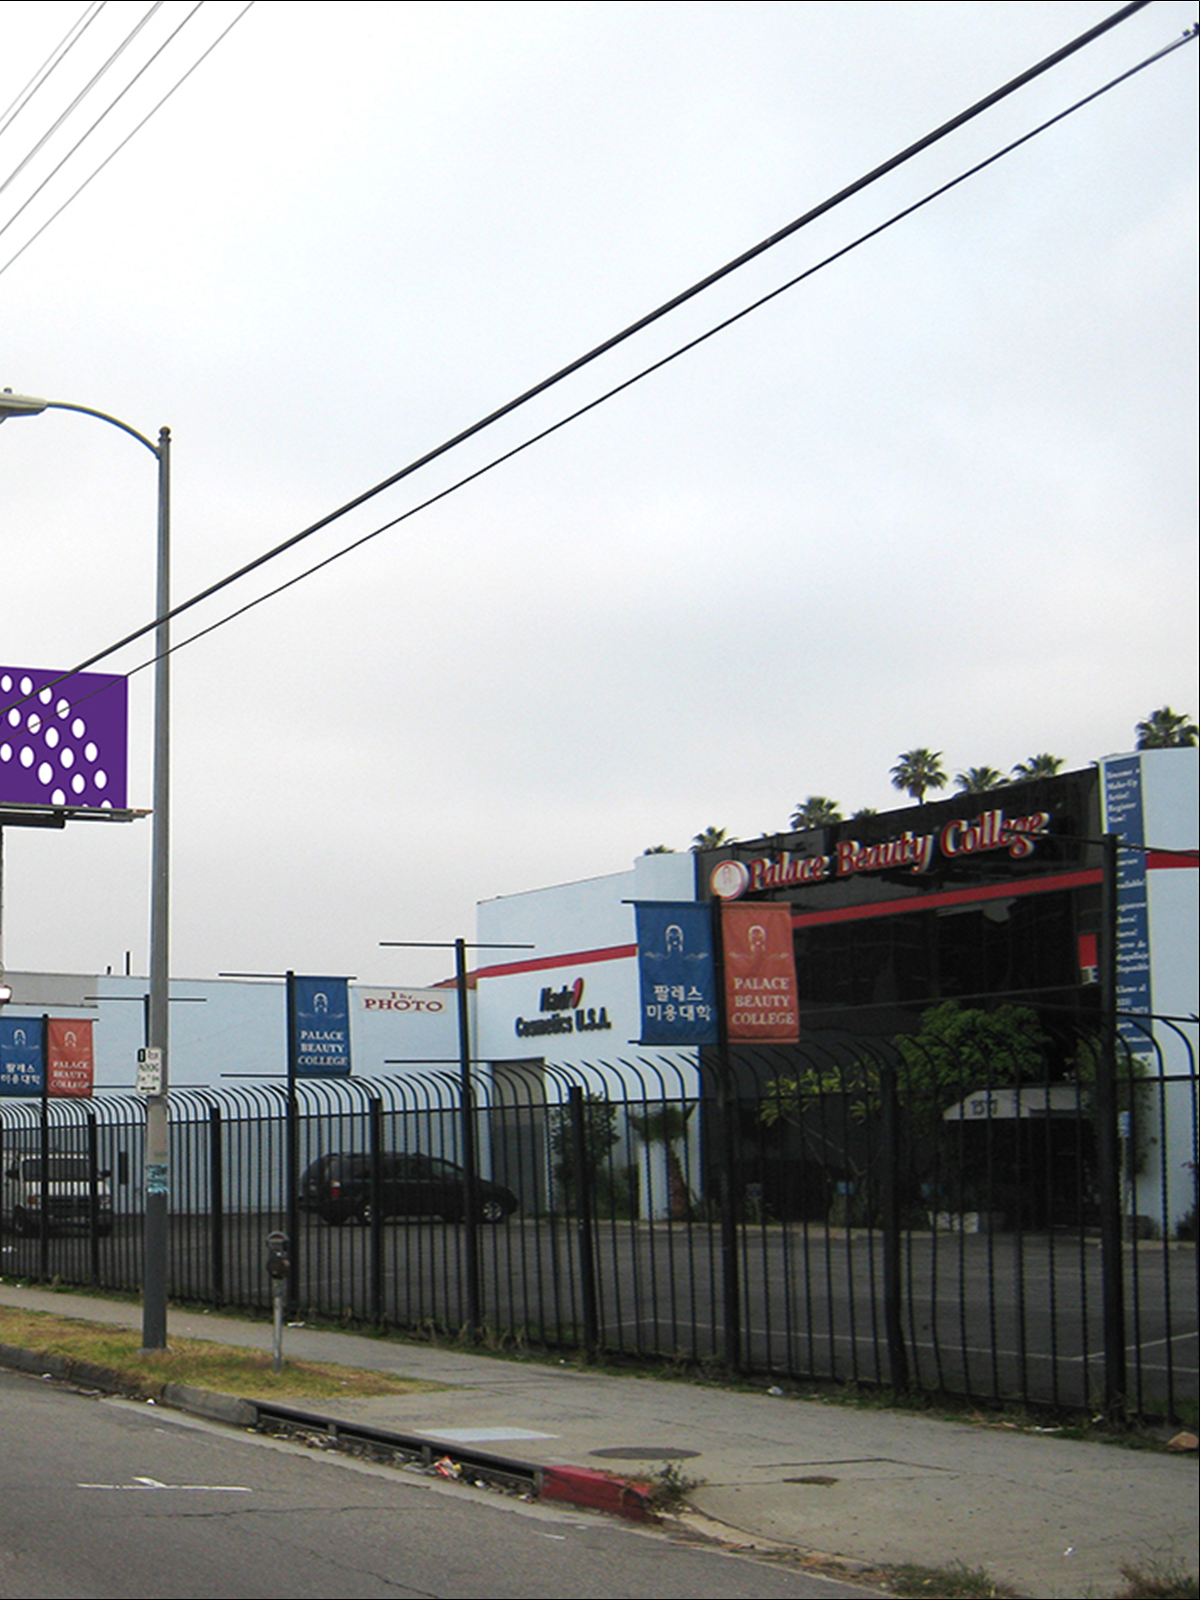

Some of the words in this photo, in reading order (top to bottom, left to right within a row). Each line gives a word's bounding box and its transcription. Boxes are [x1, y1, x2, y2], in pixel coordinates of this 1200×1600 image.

[748, 851, 830, 892] Palace
[836, 831, 933, 875] Beauty
[941, 810, 1049, 858] College
[733, 977, 790, 990] PALACE
[653, 985, 703, 1002] 팔레스
[364, 998, 443, 1012] PHOTO
[734, 995, 791, 1007] BEAUTY
[646, 1004, 712, 1022] 미용대학
[732, 1012, 795, 1025] COLLEGE
[300, 1031, 344, 1041] PALACE
[300, 1043, 345, 1053] BEAUTY
[53, 1061, 89, 1069] PALACE
[298, 1055, 348, 1066] COLLEGE
[53, 1070, 88, 1079] BEAUTY
[51, 1080, 90, 1089] COLLEGE
